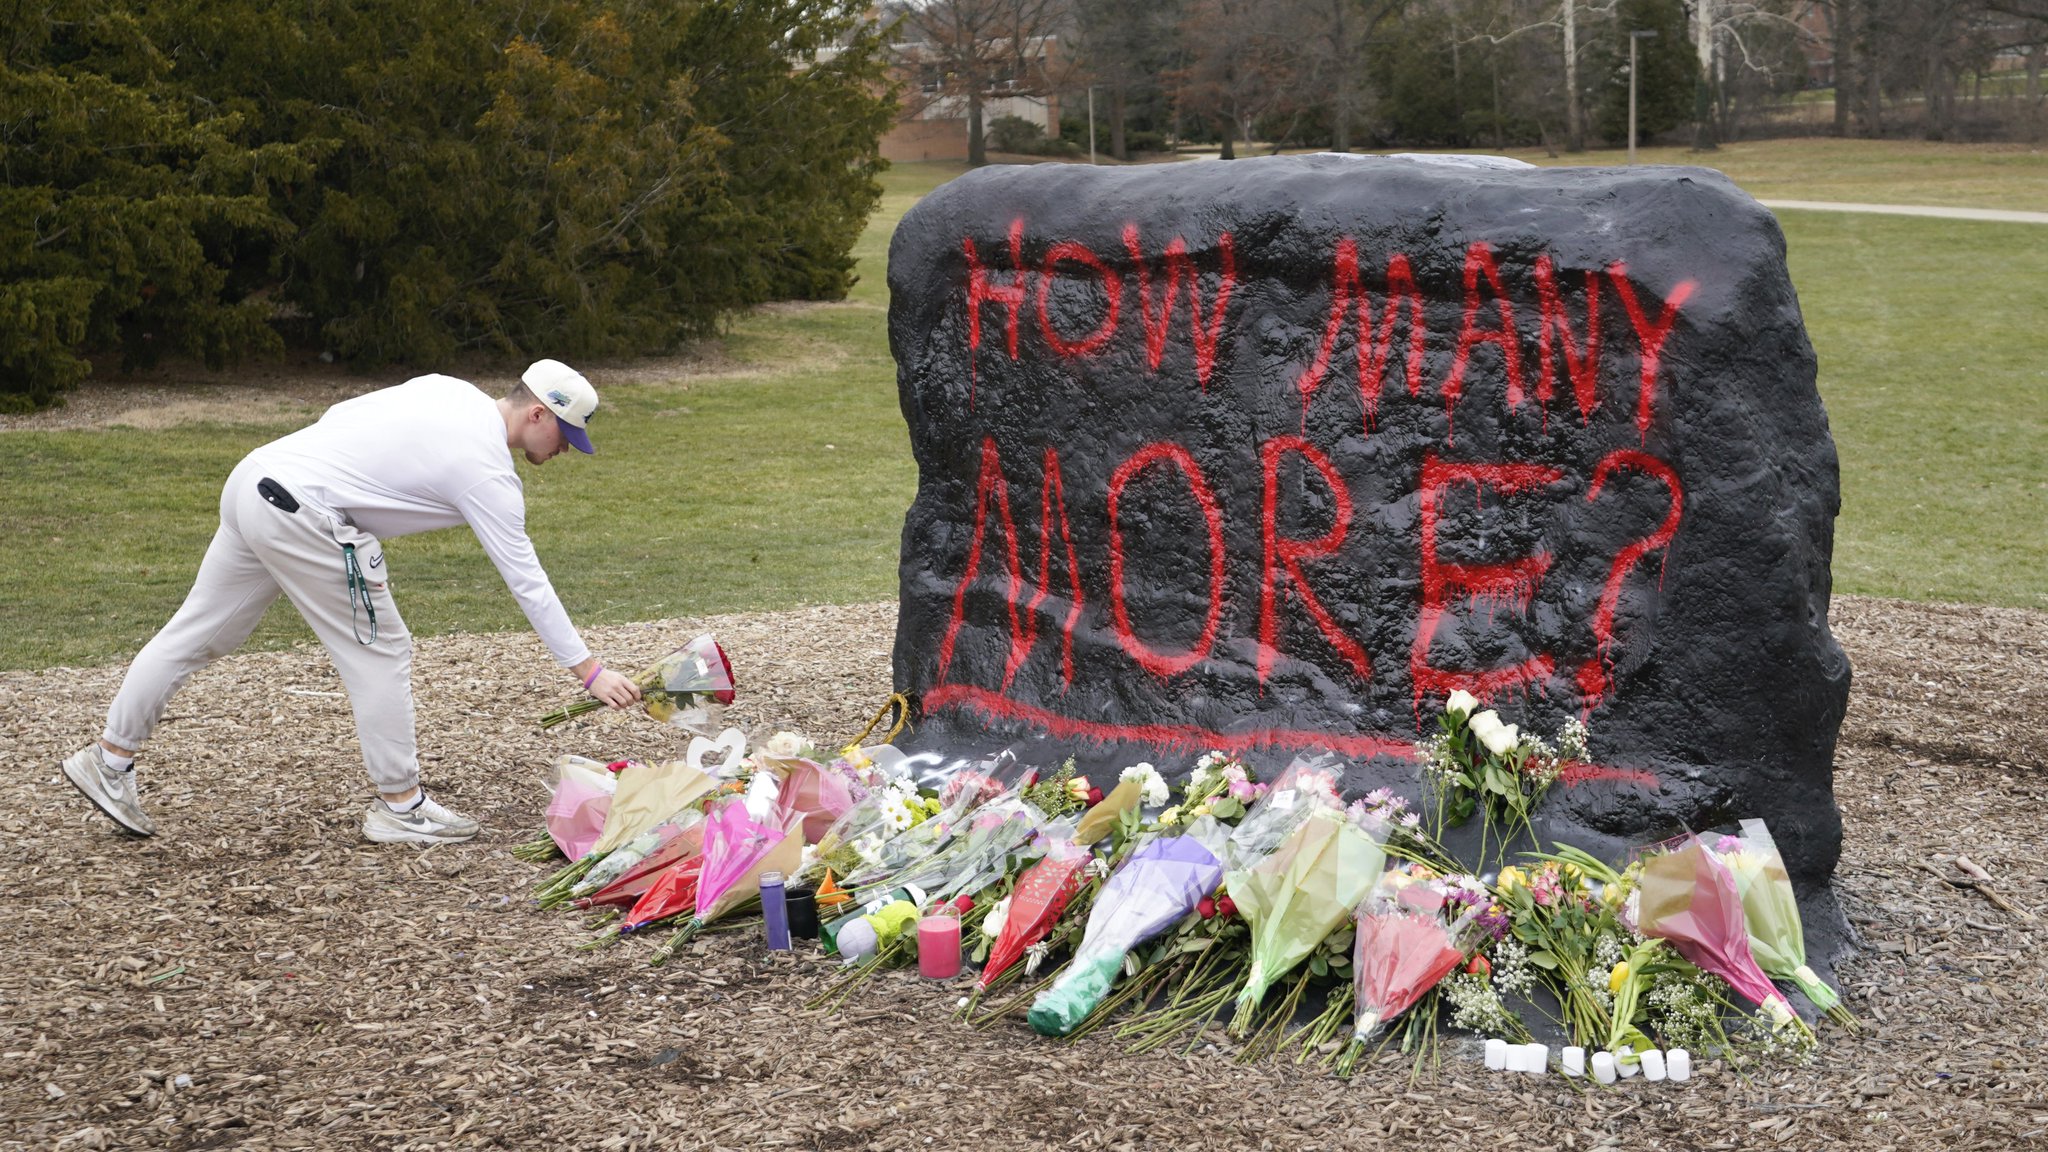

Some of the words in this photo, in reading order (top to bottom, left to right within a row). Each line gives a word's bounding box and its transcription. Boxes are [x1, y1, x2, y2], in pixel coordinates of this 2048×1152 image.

[963, 217, 1236, 389] HOW
[1297, 235, 1700, 434] MANY
[935, 435, 1684, 705] MORE?
